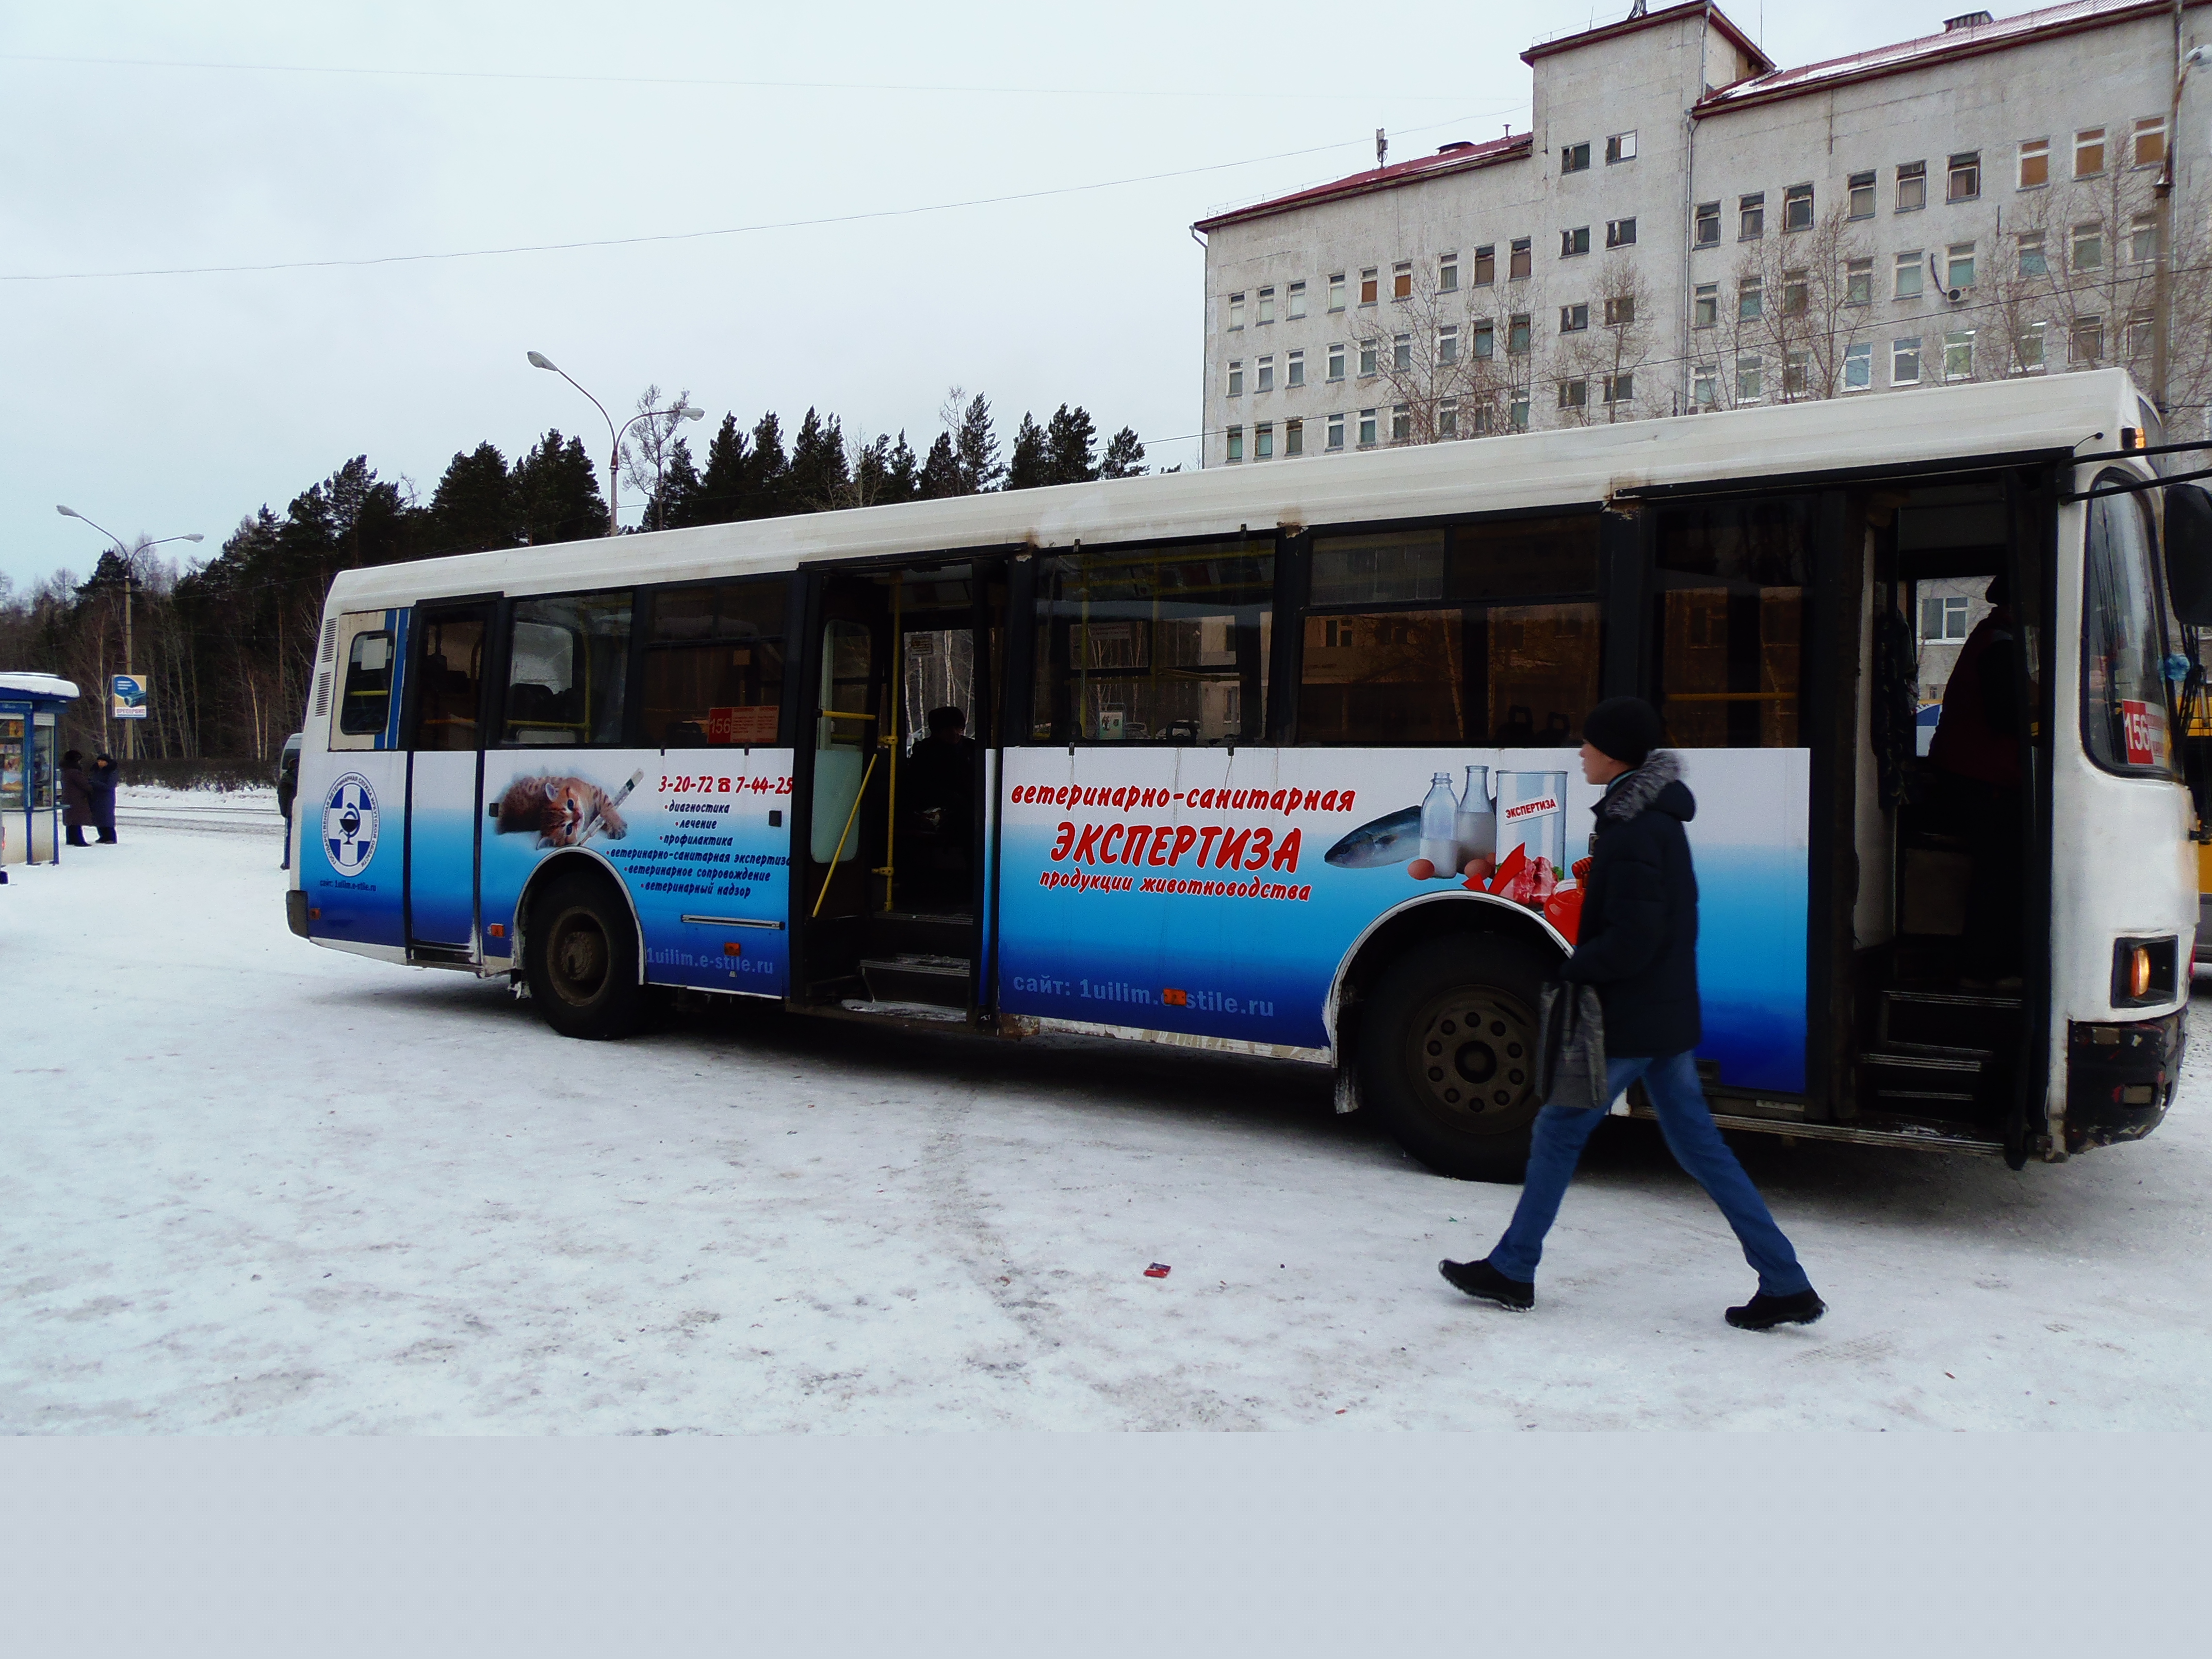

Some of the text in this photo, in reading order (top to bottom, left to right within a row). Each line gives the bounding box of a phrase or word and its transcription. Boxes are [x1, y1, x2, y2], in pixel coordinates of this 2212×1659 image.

[710, 718, 730, 734] 156
[2125, 712, 2151, 751] 156
[658, 775, 793, 794] 3-20-72 7-44-25
[669, 800, 730, 814] диагностика
[1011, 785, 1356, 816] ветеринарно-санитарная
[1505, 799, 1556, 818] ЭКСПЕРТИЗА
[679, 819, 717, 829] лечение
[663, 834, 733, 847] профилактика
[1050, 821, 1302, 873] ЭКСПЕРТИЗА
[610, 848, 730, 864] ветеринарно-санитарная
[628, 865, 771, 882] ветеринарное сопровождение
[645, 882, 751, 899] ветеринарный надзор
[1039, 868, 1312, 902] продукции животноводства
[646, 947, 773, 974] 1uilim.e-stile.ru
[1013, 974, 1274, 1017] сайт: 1uilim.stile.ru
